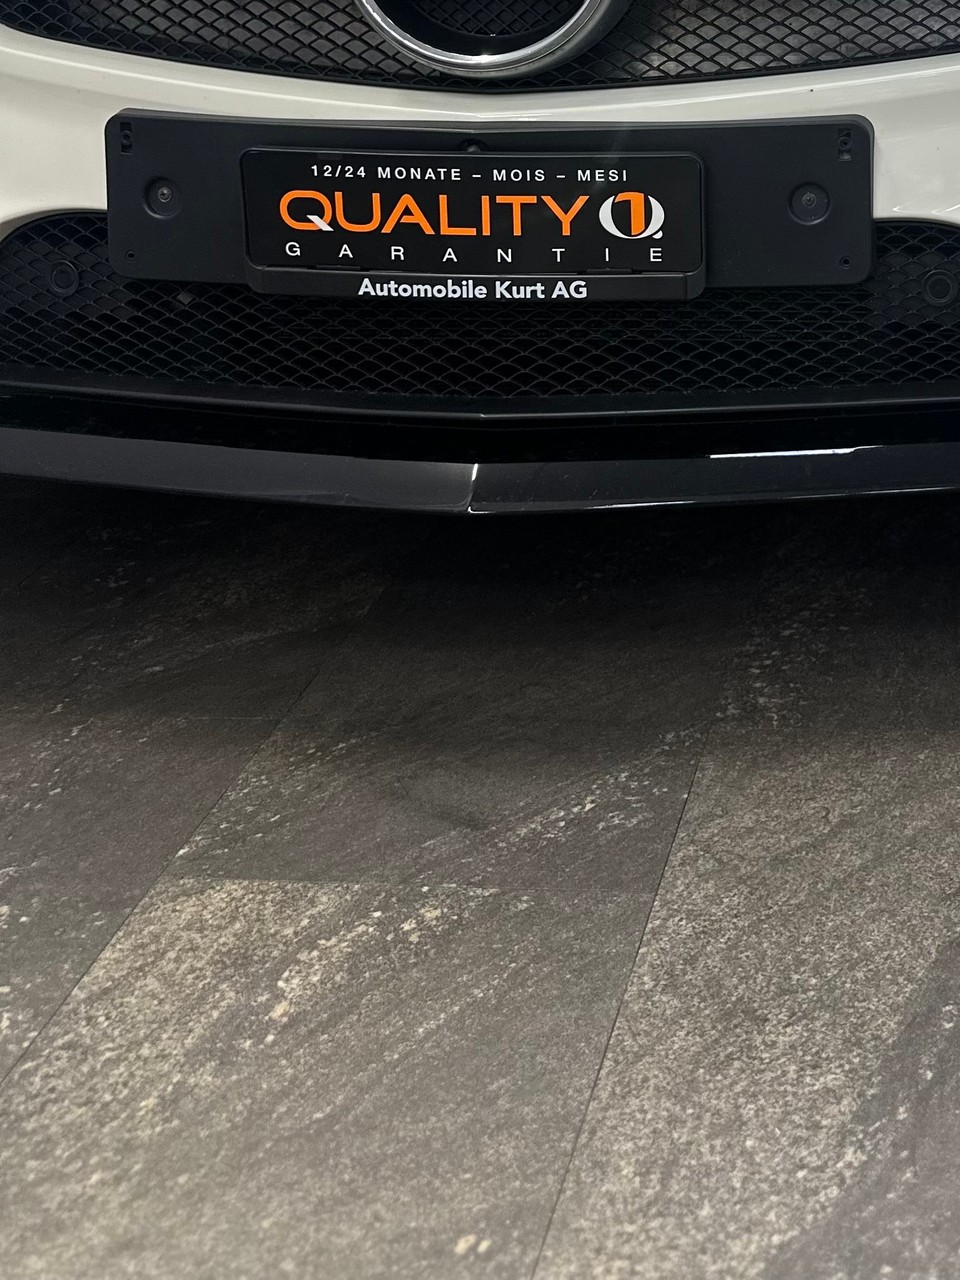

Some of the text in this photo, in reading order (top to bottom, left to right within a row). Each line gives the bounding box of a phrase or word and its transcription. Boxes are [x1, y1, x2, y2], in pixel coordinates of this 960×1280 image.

[312, 165, 365, 177] 12/24
[378, 167, 460, 180] MONATE
[493, 170, 544, 181] MOIS
[578, 170, 626, 181] MESI
[280, 190, 589, 236] QUALITY
[286, 242, 662, 262] GARANTIE
[358, 278, 587, 298] Automobile Kurt AG
